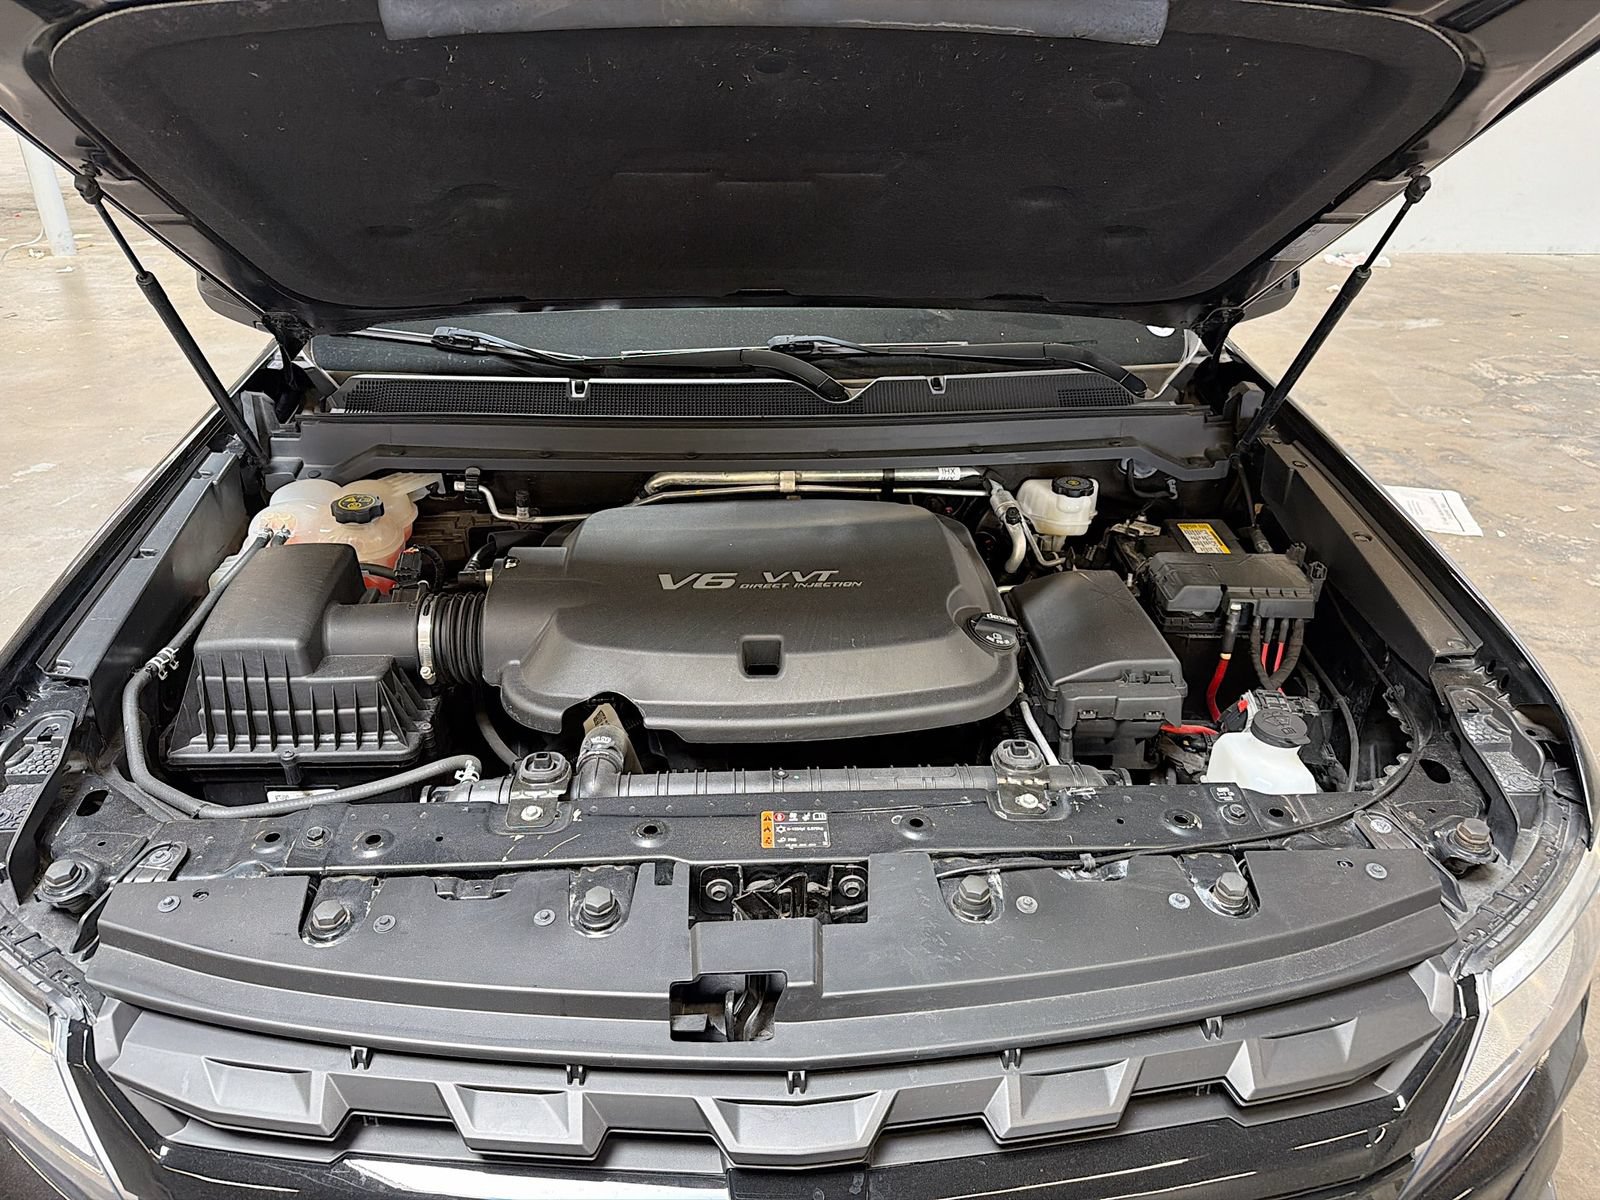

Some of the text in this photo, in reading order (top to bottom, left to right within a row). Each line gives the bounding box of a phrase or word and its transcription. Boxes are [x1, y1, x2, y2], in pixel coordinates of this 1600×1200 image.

[658, 570, 840, 590] V6 VVT
[793, 581, 863, 589] INJECTION
